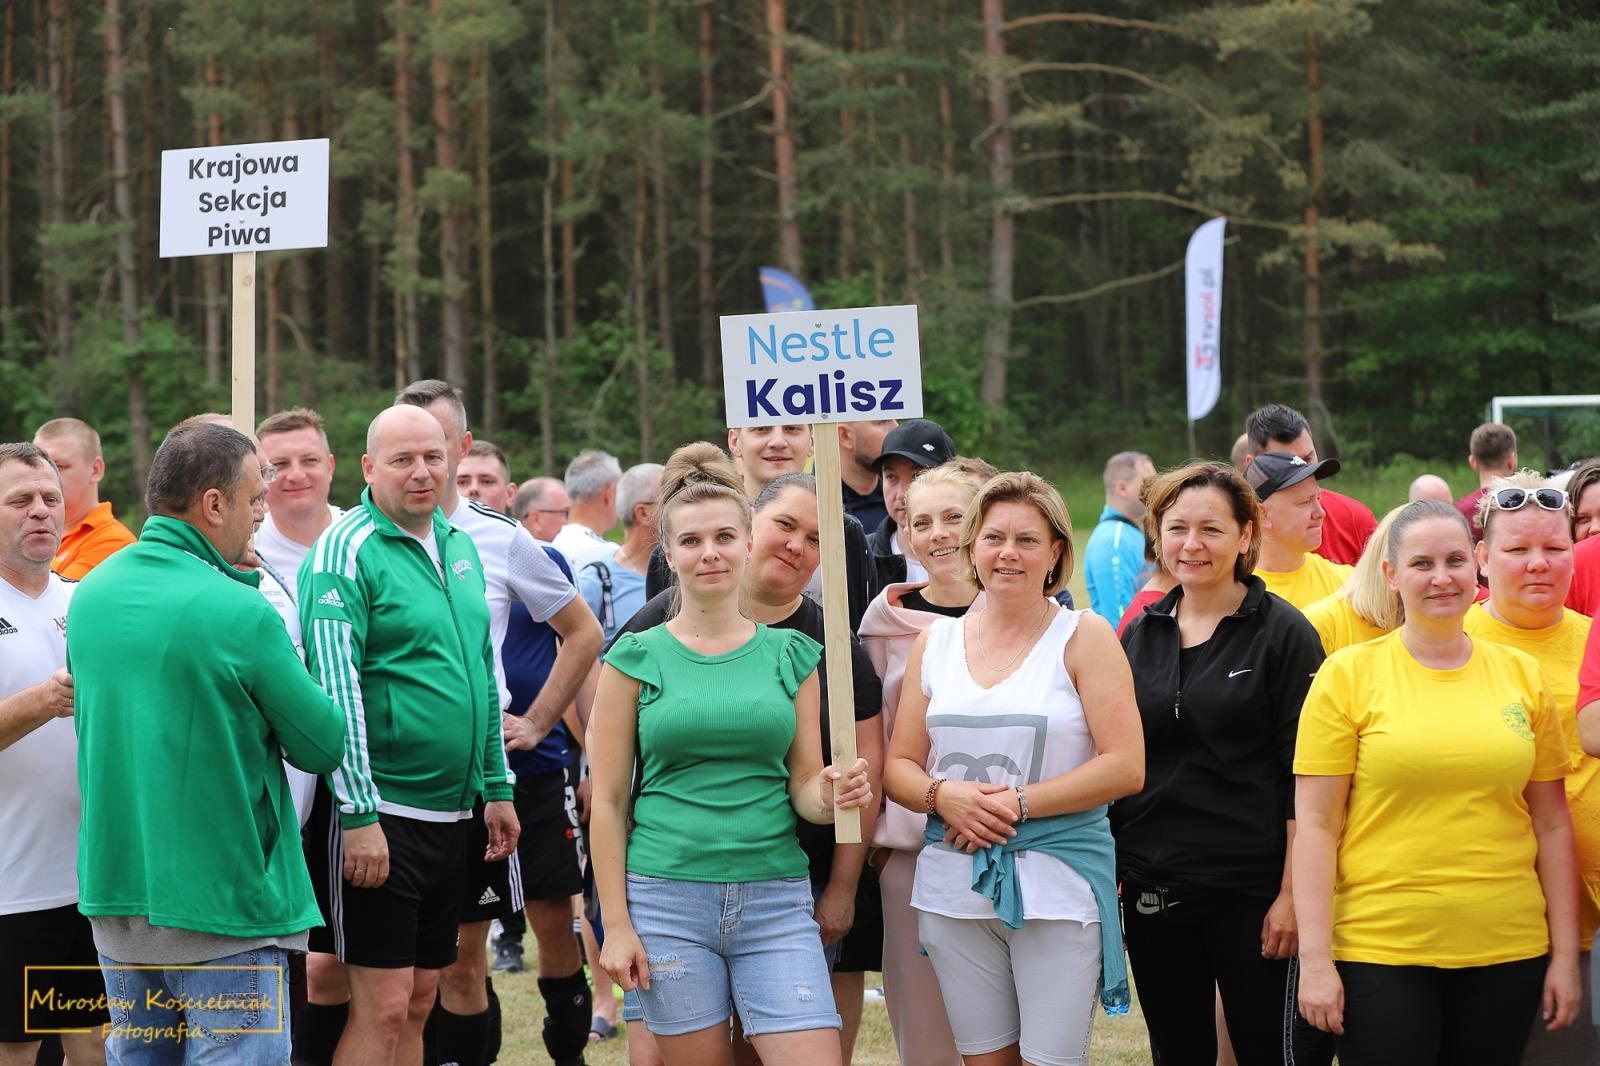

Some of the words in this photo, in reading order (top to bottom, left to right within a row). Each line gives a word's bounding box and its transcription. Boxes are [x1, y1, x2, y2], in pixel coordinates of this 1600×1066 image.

[188, 152, 299, 184] Krajowa
[198, 185, 287, 217] Sekcja
[208, 222, 271, 247] Piwa
[747, 318, 895, 365] Nestle
[746, 369, 905, 418] Kalisz
[317, 598, 345, 609] adidas
[478, 895, 501, 905] adidas
